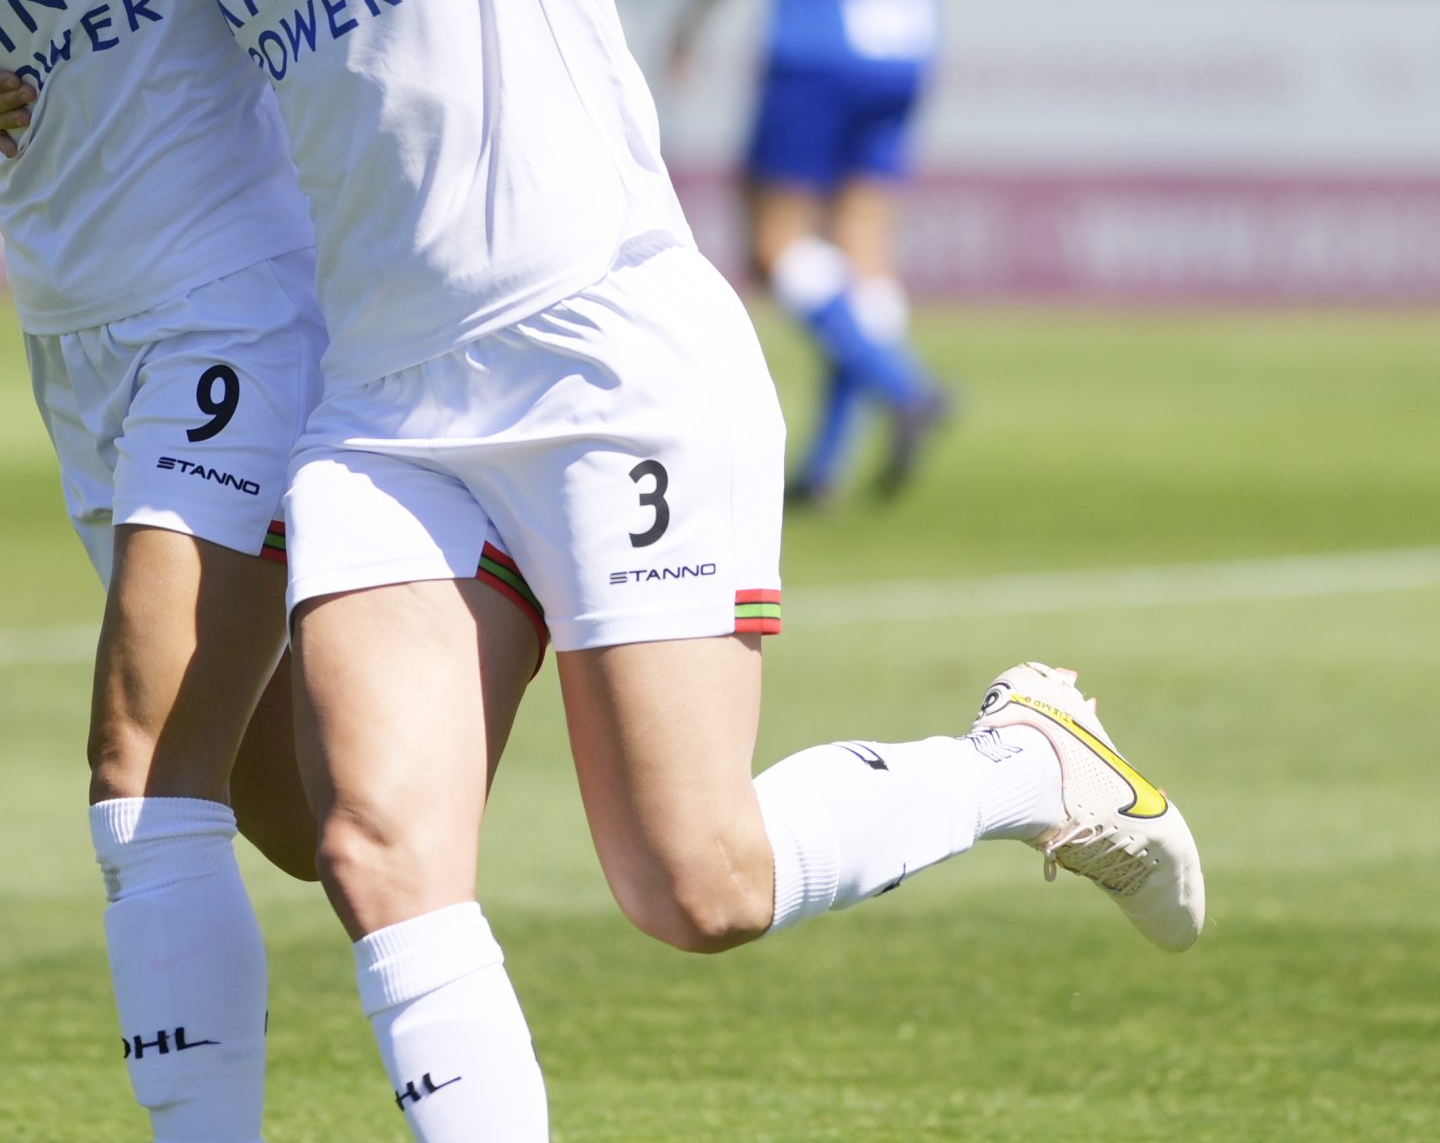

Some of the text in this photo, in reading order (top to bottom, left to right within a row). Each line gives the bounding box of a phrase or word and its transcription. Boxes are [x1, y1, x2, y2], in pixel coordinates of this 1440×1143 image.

[186, 364, 240, 442] 9
[157, 456, 260, 496] STANNO
[629, 459, 670, 548] 3
[609, 563, 716, 585] STANNO
[395, 1073, 462, 1111] HL
